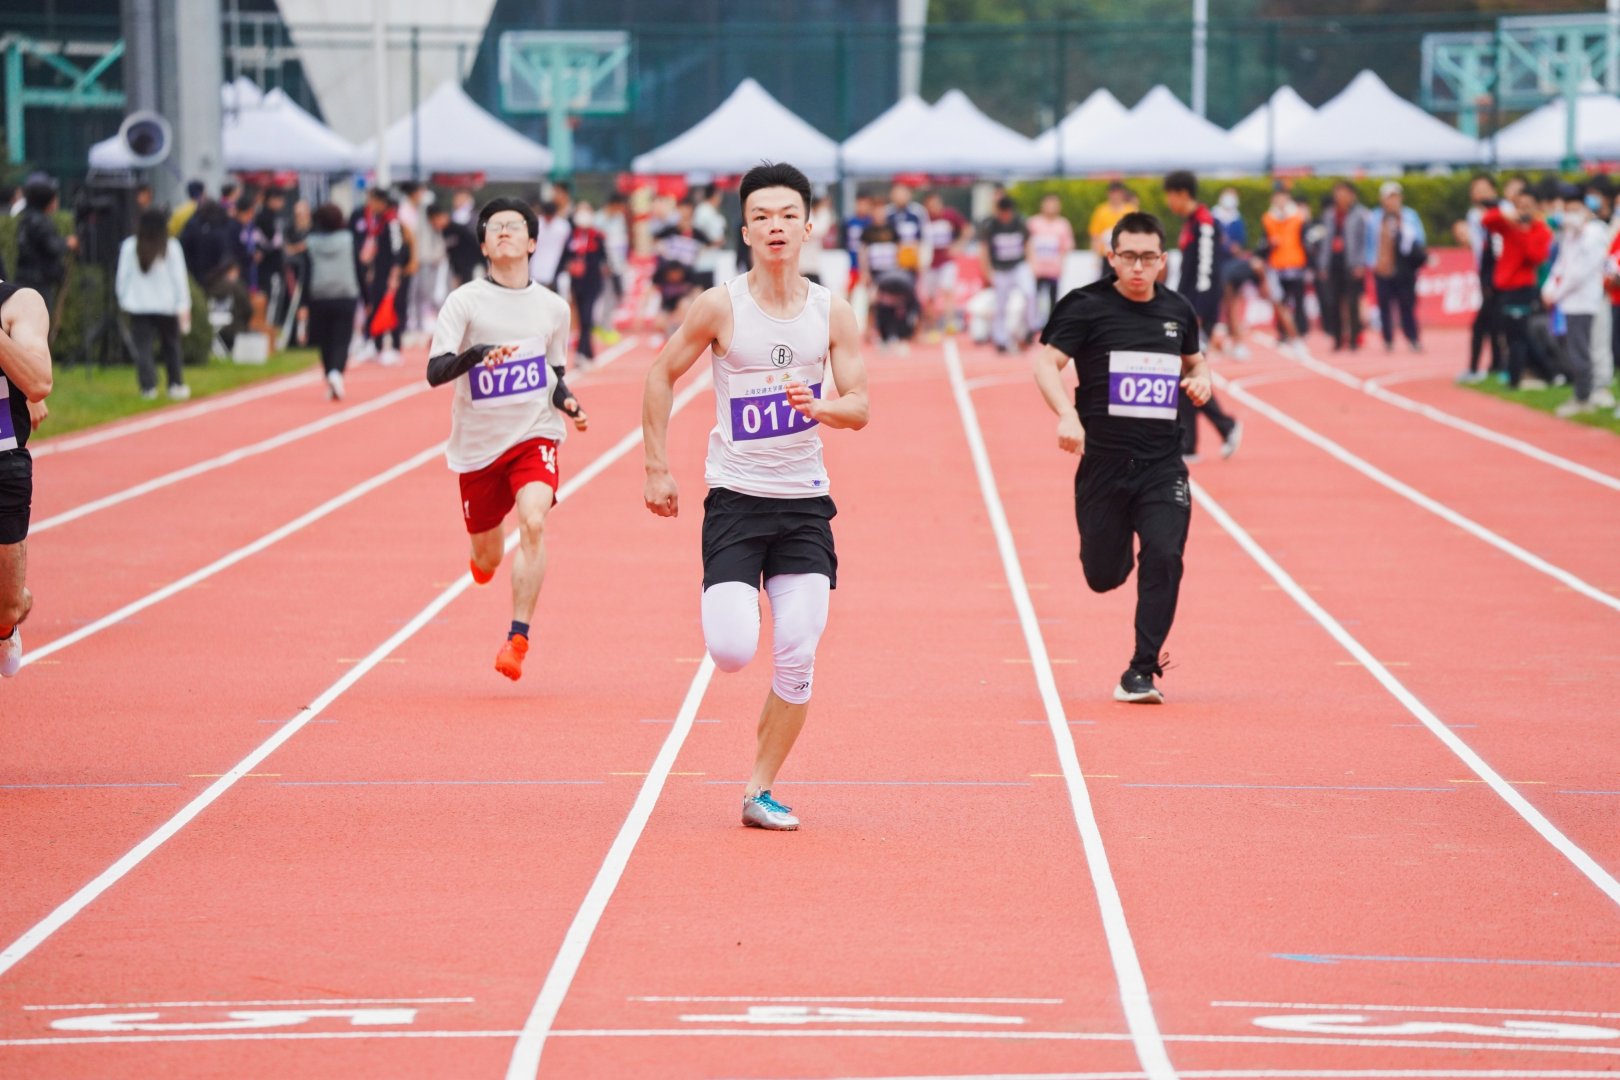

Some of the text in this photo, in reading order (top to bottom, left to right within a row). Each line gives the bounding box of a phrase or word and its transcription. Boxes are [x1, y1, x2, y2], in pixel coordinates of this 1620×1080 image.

[778, 348, 786, 365] B
[478, 361, 540, 395] 0726
[1119, 377, 1177, 405] 0297
[742, 401, 812, 434] 017
